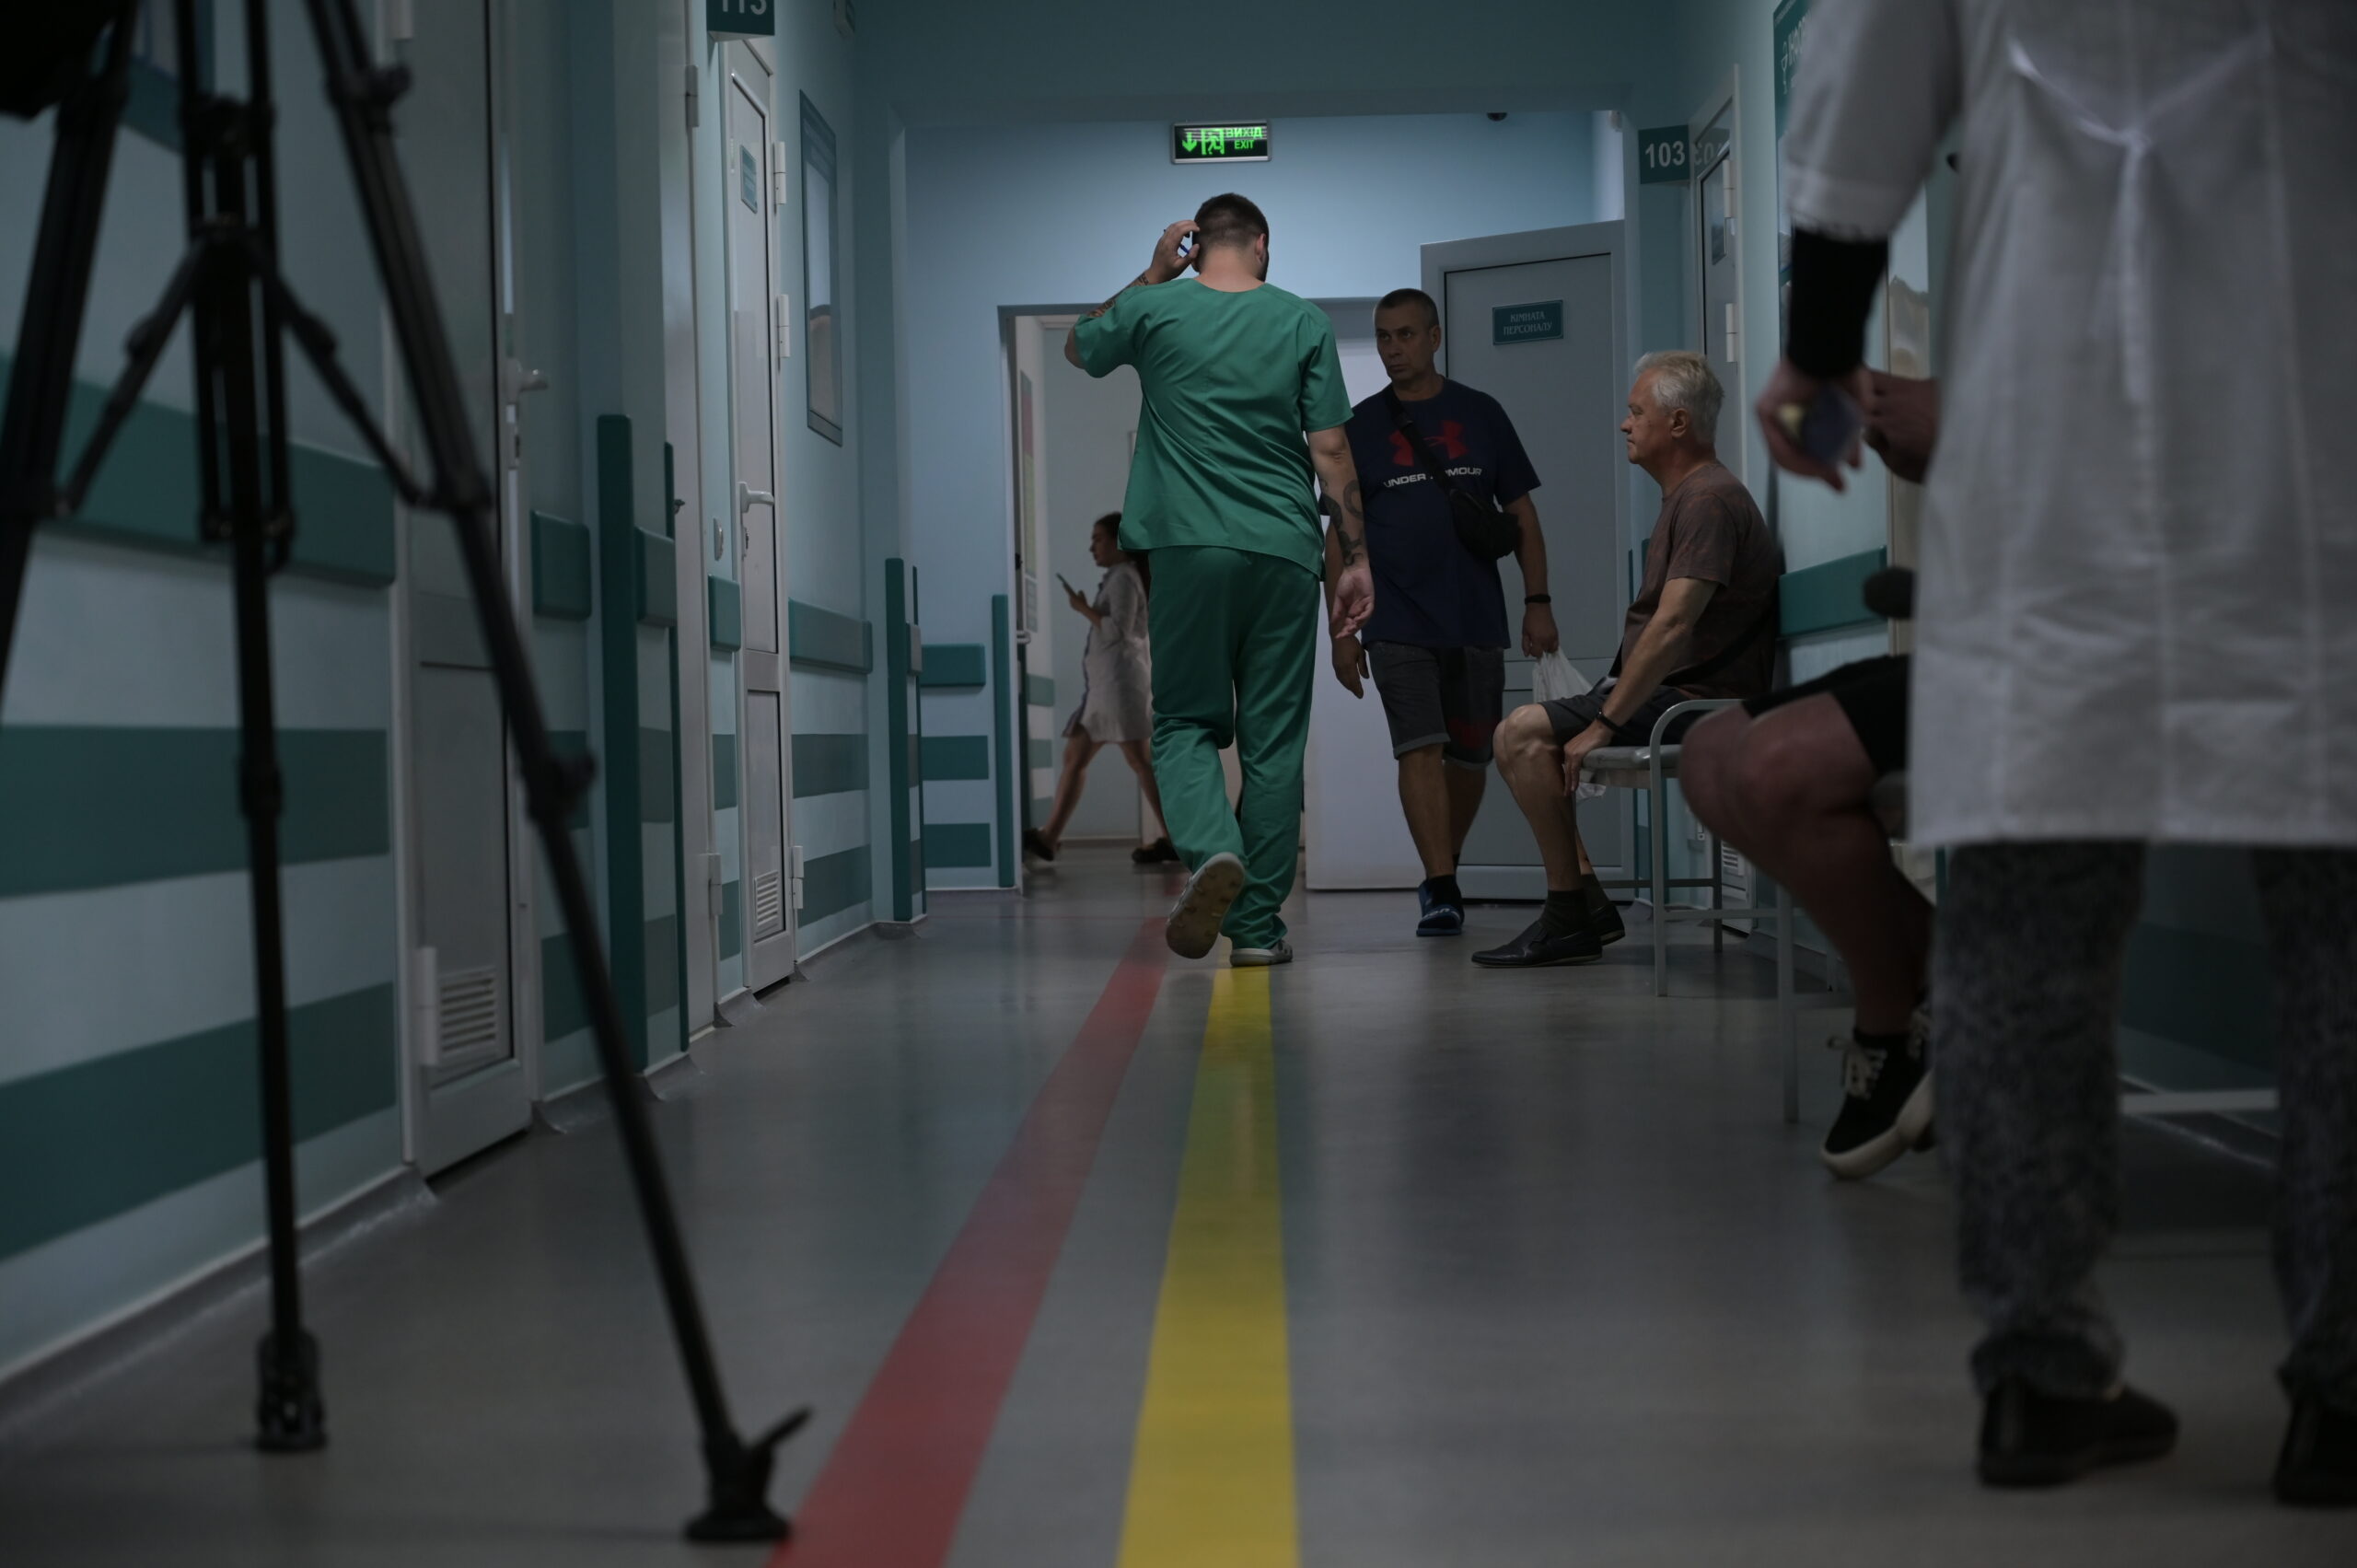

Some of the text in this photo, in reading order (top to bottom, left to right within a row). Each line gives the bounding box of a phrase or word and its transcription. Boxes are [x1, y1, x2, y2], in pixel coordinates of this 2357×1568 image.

[1234, 140, 1254, 149] EXIT
[1644, 141, 1685, 168] 103
[1510, 311, 1546, 322] КІМНАТА
[1504, 320, 1552, 334] ПЕРСОНАЛУ
[1383, 467, 1482, 488] UNDER MOUR
